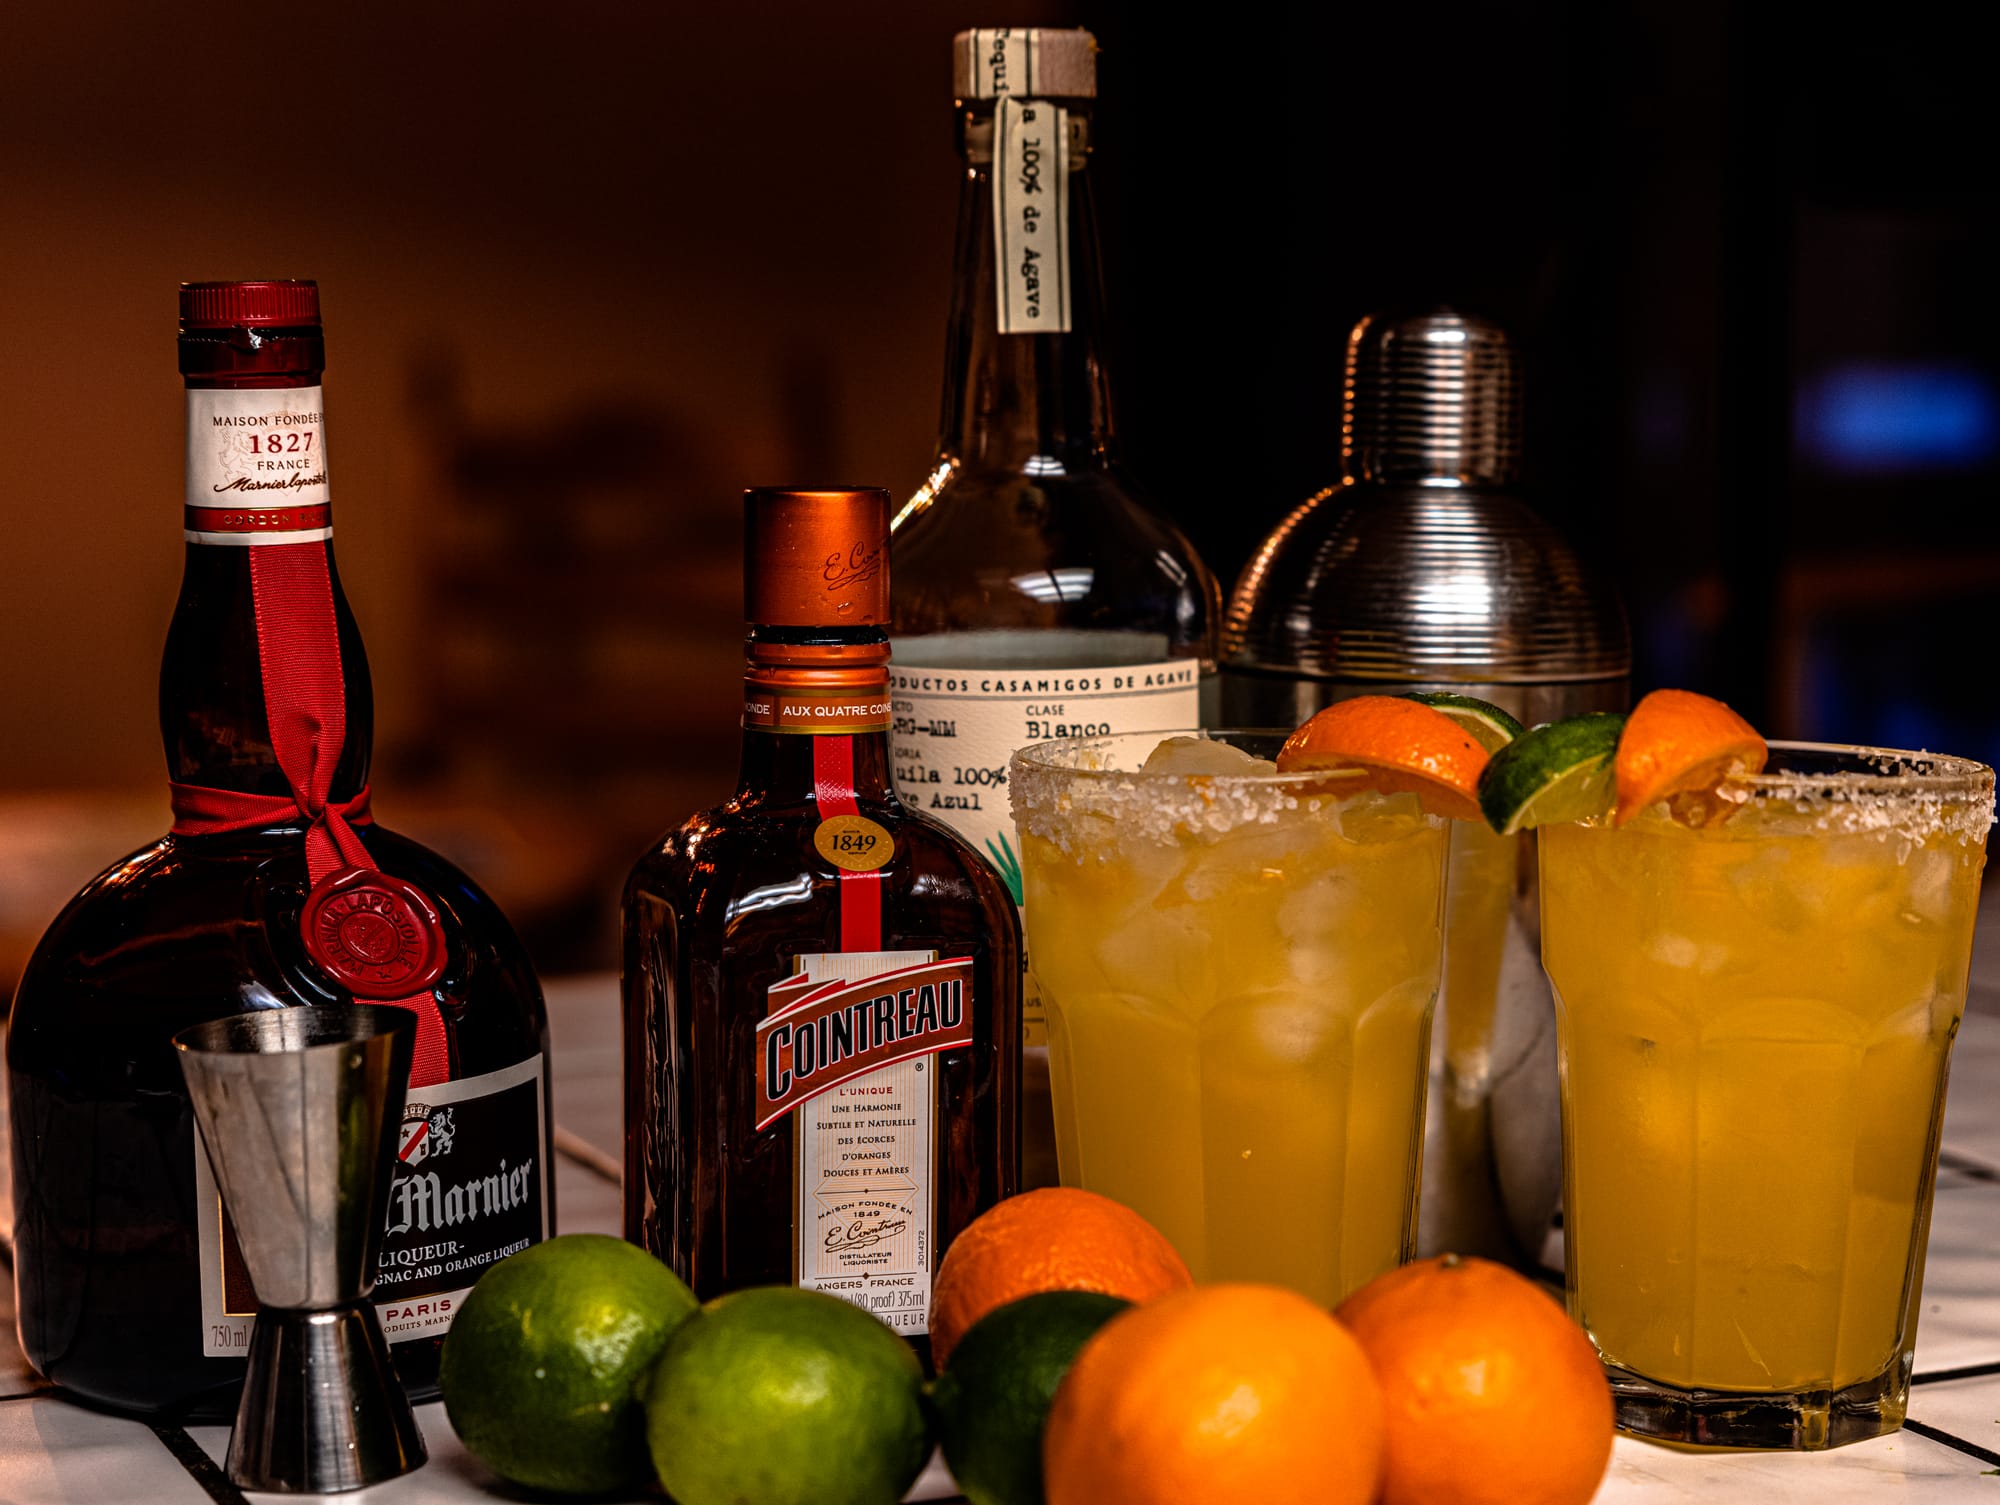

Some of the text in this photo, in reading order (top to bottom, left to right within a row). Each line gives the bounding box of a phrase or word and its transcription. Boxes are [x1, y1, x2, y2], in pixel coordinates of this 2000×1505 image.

[1018, 137, 1042, 195] 100%
[1023, 206, 1041, 234] de
[1020, 247, 1042, 319] Agave
[212, 415, 269, 427] MAISON
[274, 411, 318, 426] FONDÉE
[249, 431, 313, 454] 1827
[257, 458, 310, 471] FRANCE
[981, 677, 1101, 694] CASAMIGOS
[1114, 674, 1134, 690] DE
[1144, 669, 1192, 686] AGAVE
[783, 705, 811, 717] AUX
[814, 704, 868, 717] QUATRE
[1026, 704, 1065, 717] CLASE
[1025, 720, 1111, 740] Blanco
[953, 765, 1008, 789] 100%
[929, 792, 982, 811] Azul
[831, 834, 877, 851] 1849
[766, 979, 963, 1101] COINTREAU
[839, 1086, 893, 1096] L'UNIQUE
[386, 1158, 533, 1238] Marnier
[817, 1201, 913, 1220] MAISON FONDÉE EN
[853, 1210, 881, 1218] 1849
[839, 1251, 892, 1260] DISTILLATEUR
[917, 1230, 925, 1267] 3014372
[375, 1237, 531, 1286] GNAC AND ORANGE LIQUEUR
[843, 1258, 889, 1266] LIQUORISTE
[816, 1277, 915, 1291] ANGERS FRANCE
[870, 1290, 895, 1311] proof)
[897, 1289, 925, 1307] 375ml
[386, 1299, 452, 1322] PARIS
[211, 1324, 248, 1348] 750 ml
[383, 1320, 421, 1334] ODUITS
